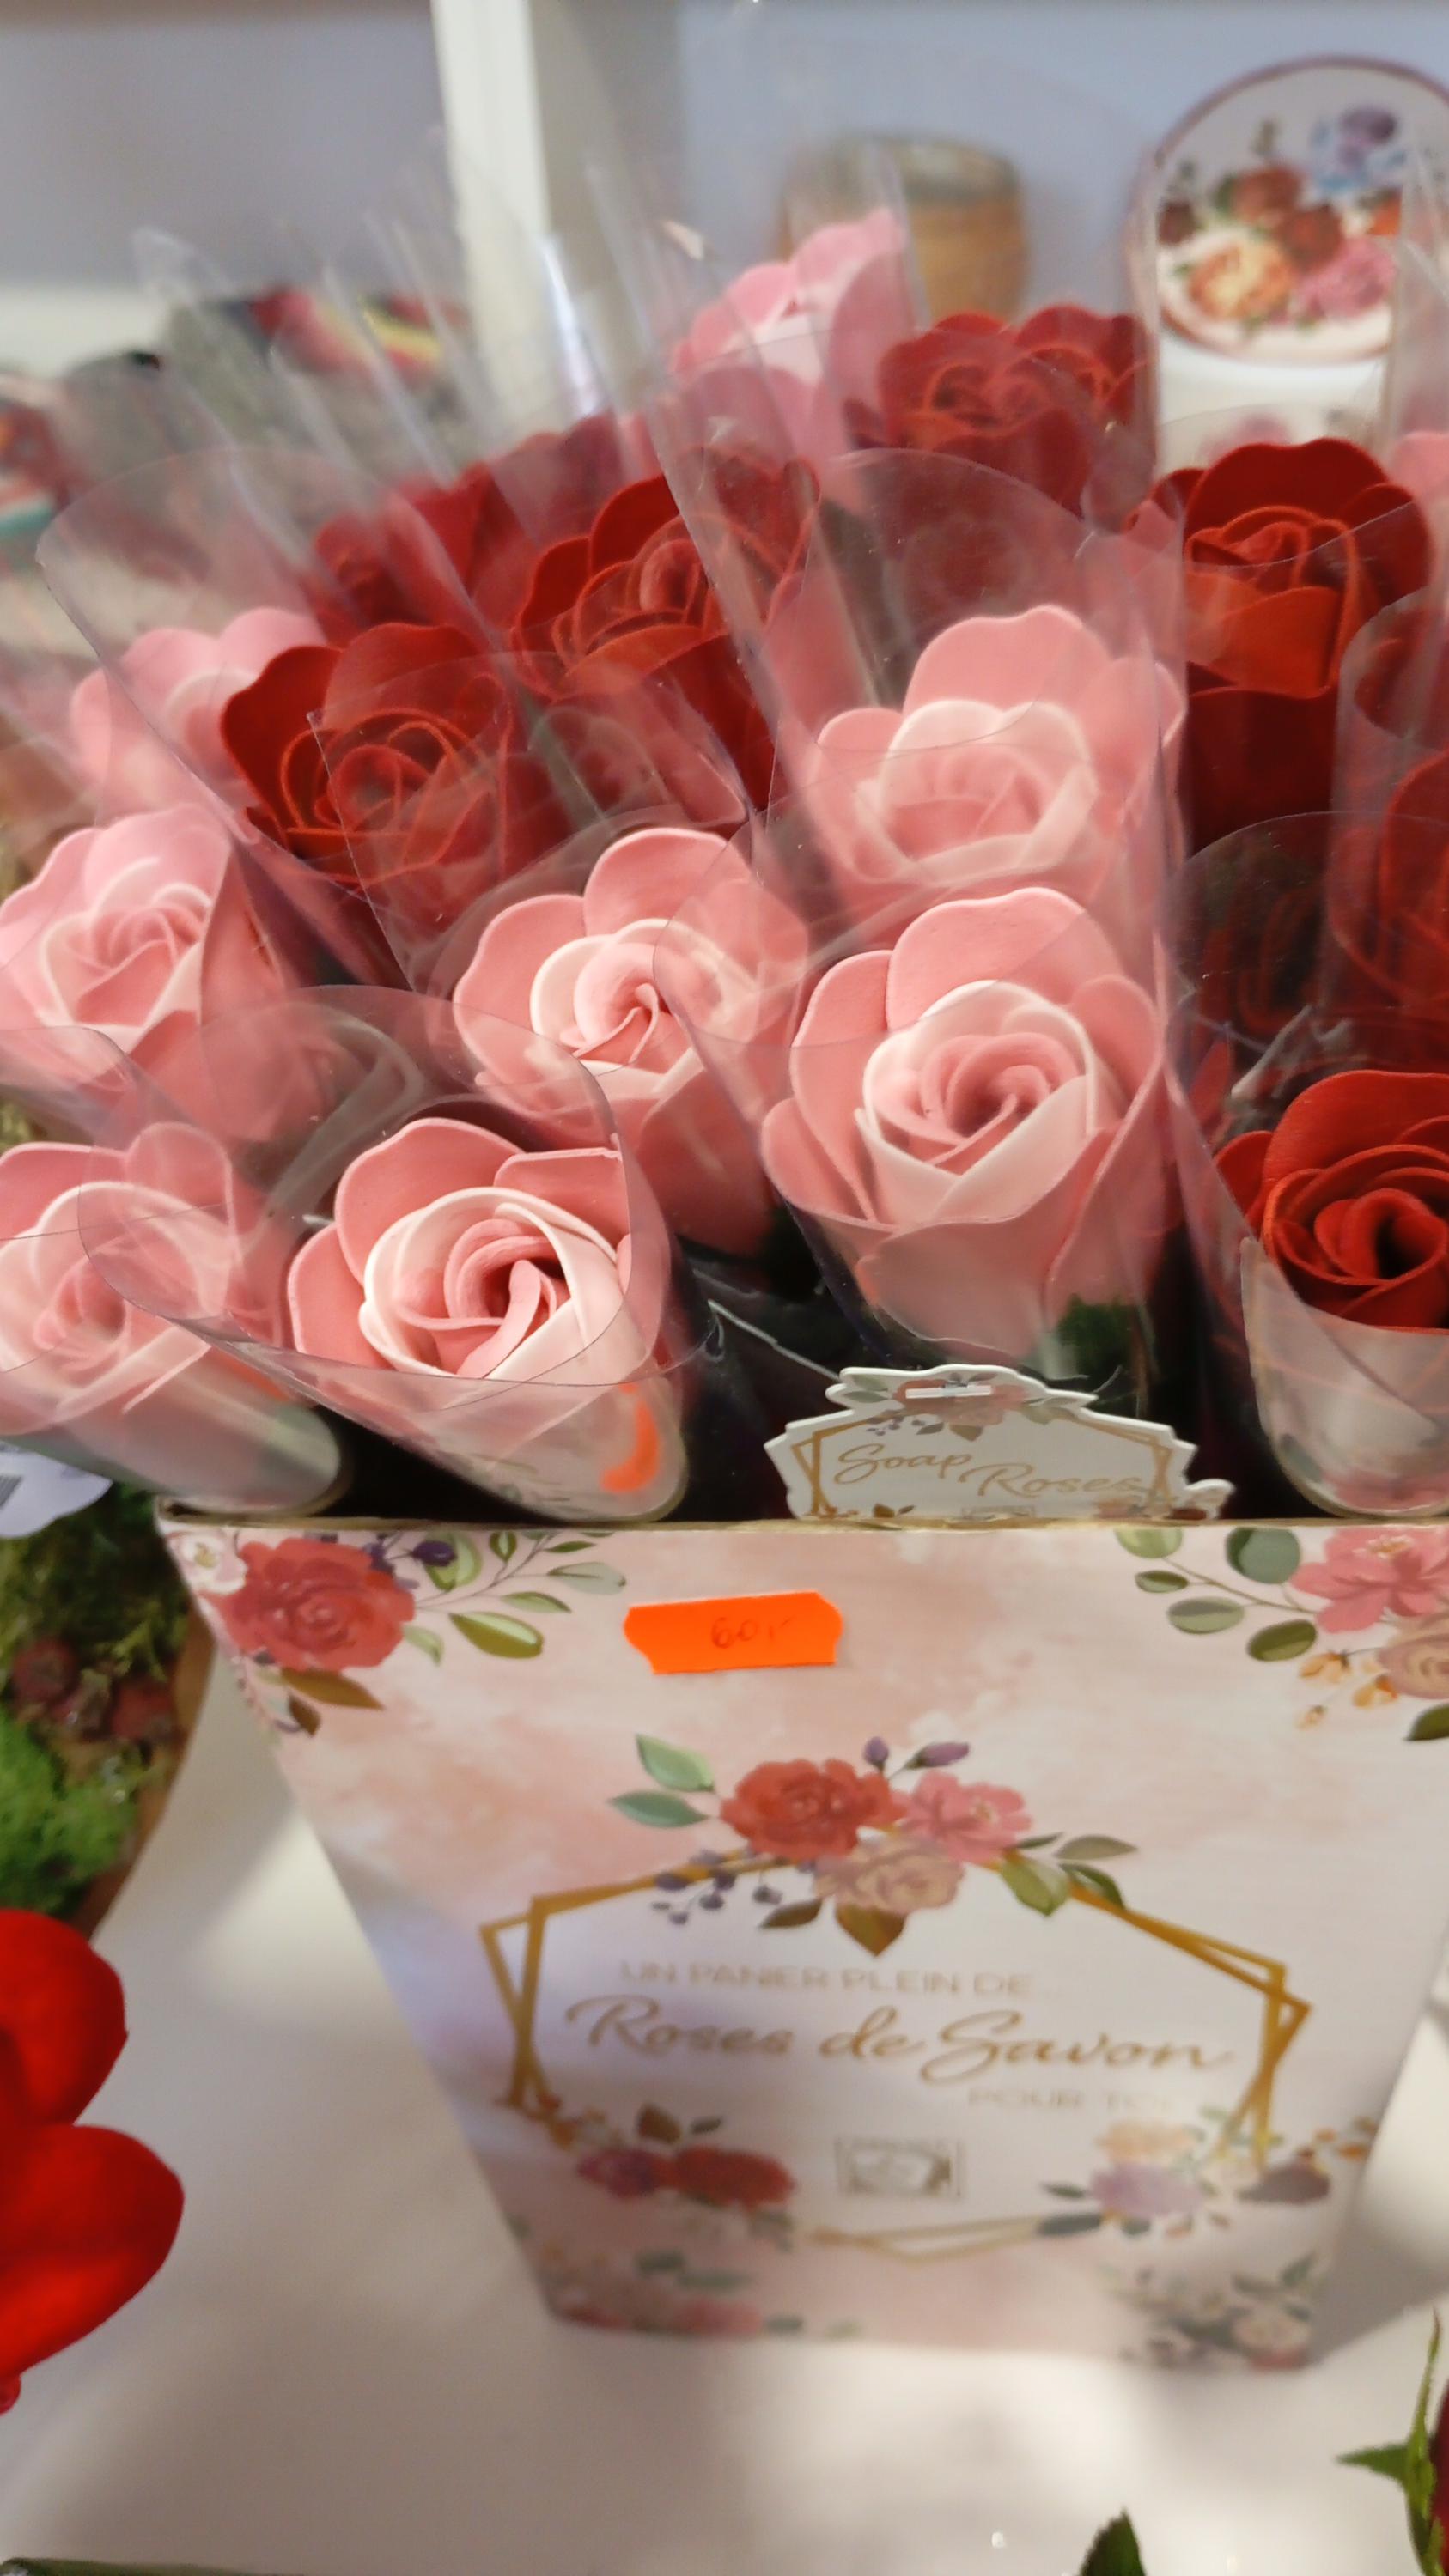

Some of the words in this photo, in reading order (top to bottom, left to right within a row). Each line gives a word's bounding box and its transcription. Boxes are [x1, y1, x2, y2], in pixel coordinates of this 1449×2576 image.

[833, 1443, 973, 1485] Soap
[957, 1462, 1151, 1498] Roses
[619, 1960, 677, 1984] UN
[688, 1961, 827, 1989] PANIER
[840, 1968, 961, 1993] PLEIN
[564, 1994, 794, 2057] Roses
[819, 2005, 926, 2058] de
[920, 2010, 1235, 2085] Savon
